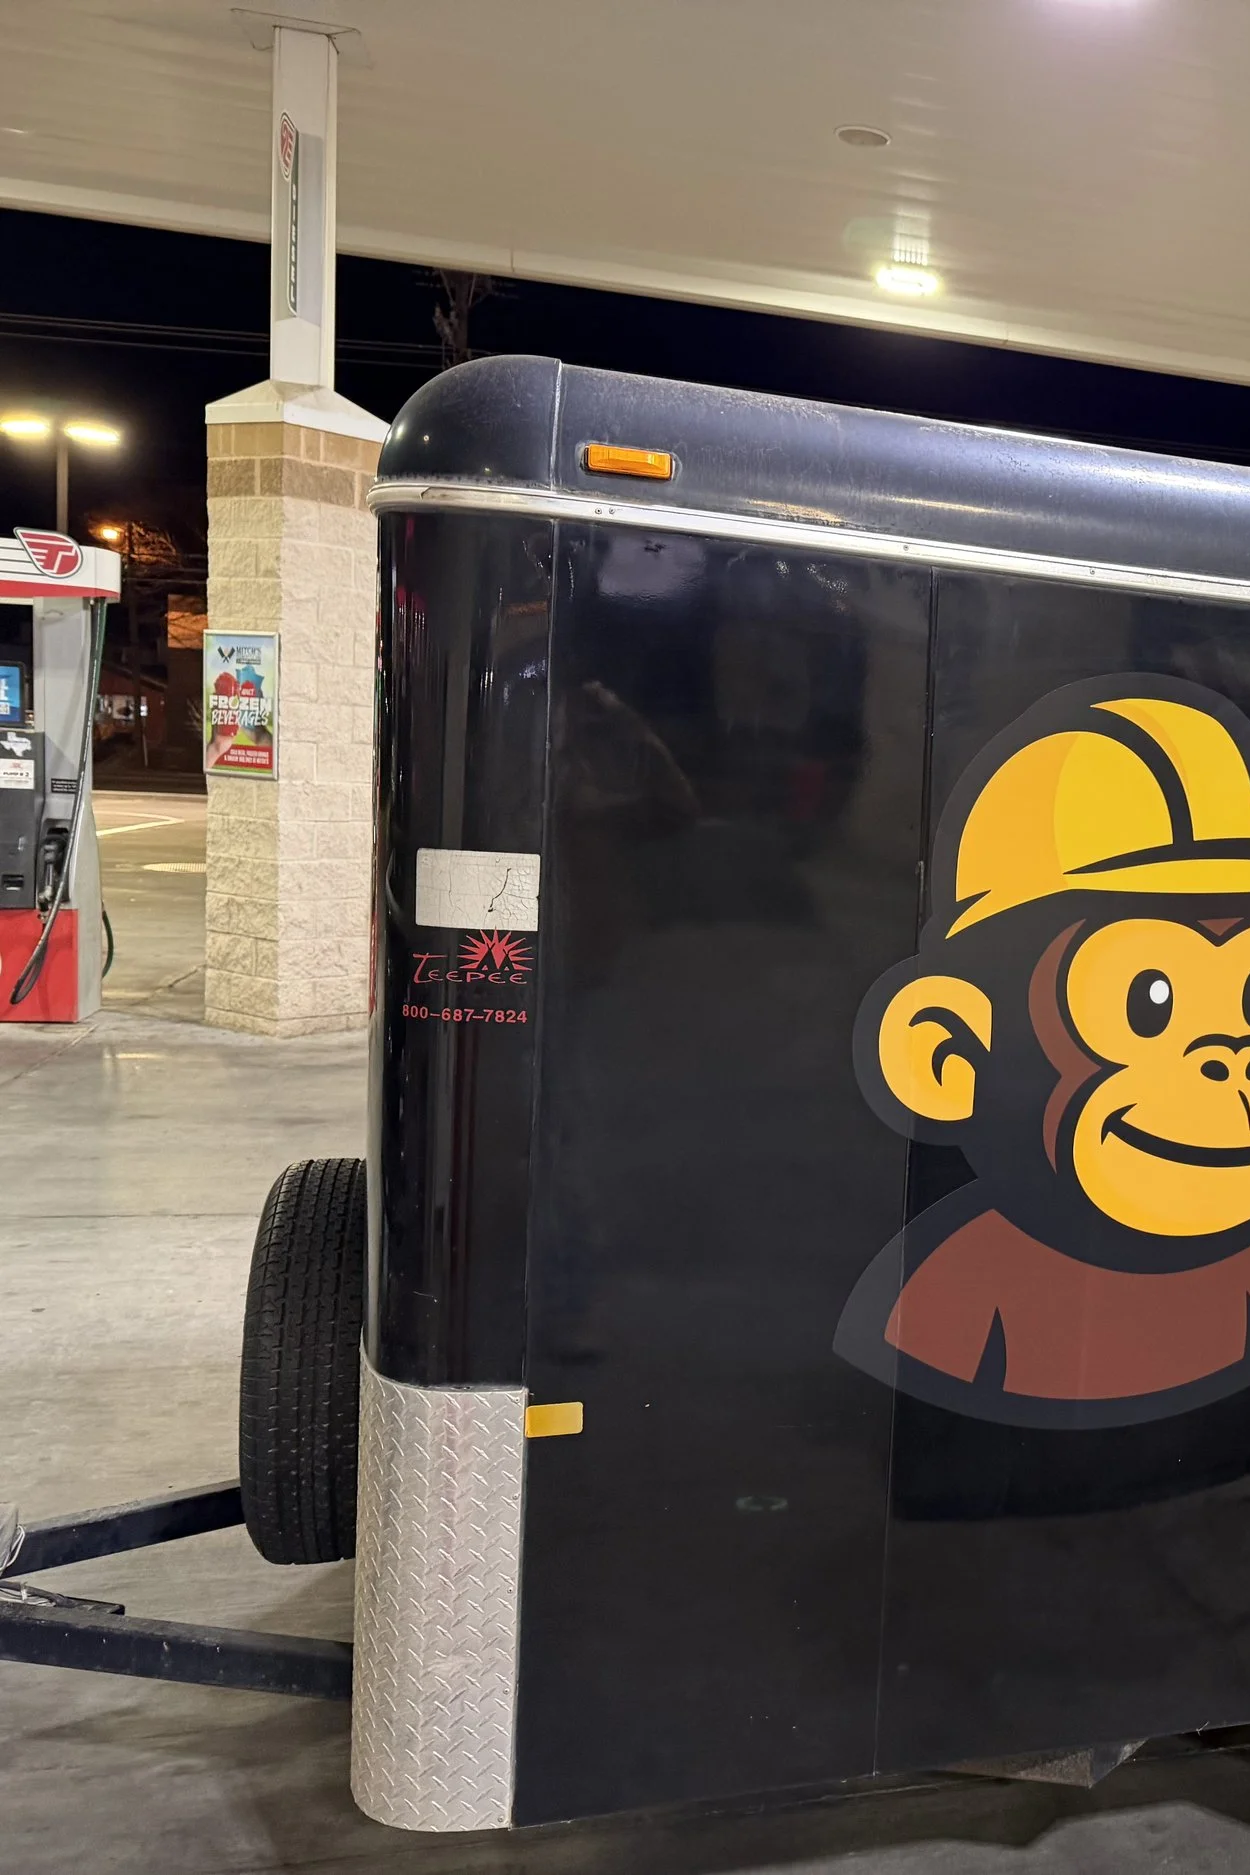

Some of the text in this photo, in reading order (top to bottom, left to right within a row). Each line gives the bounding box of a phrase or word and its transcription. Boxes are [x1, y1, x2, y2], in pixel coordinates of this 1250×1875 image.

[209, 695, 271, 711] FROZEN
[211, 709, 270, 727] BEVERAGES
[402, 1004, 528, 1024] 800-687-7824
